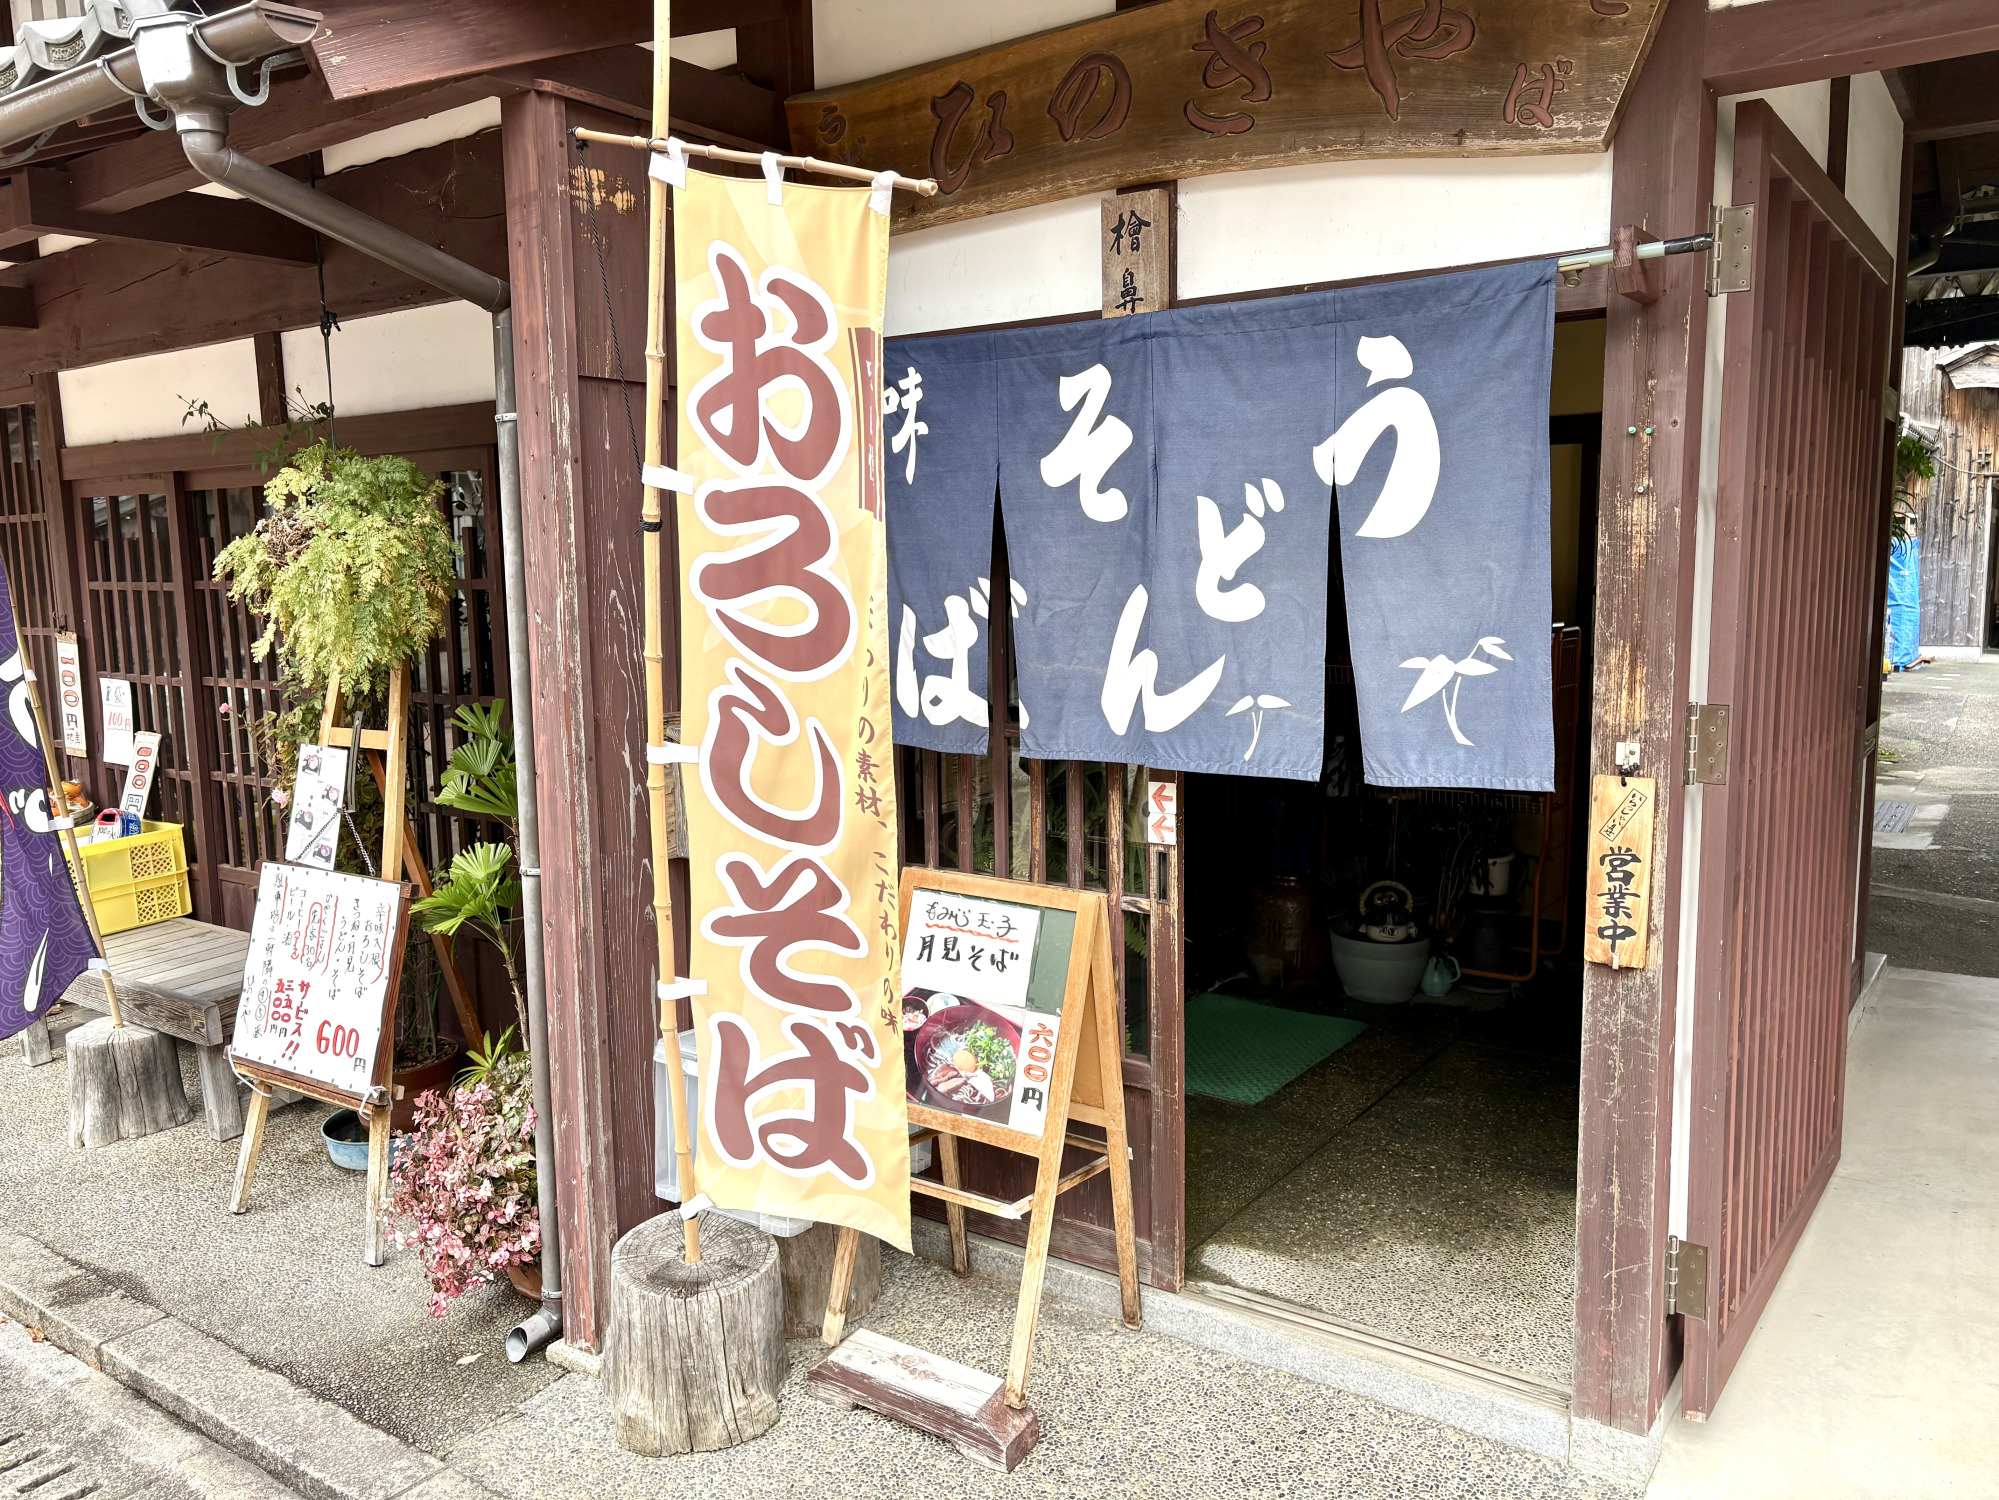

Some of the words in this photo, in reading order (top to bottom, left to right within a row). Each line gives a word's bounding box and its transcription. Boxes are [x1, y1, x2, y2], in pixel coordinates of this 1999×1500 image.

[1110, 209, 1151, 314] 檜鼻
[896, 363, 1133, 730] そば
[1101, 335, 1440, 736] うどん
[692, 248, 878, 1185] おろしそば
[916, 934, 1020, 973] 月見そば
[1597, 845, 1642, 954] 営業中
